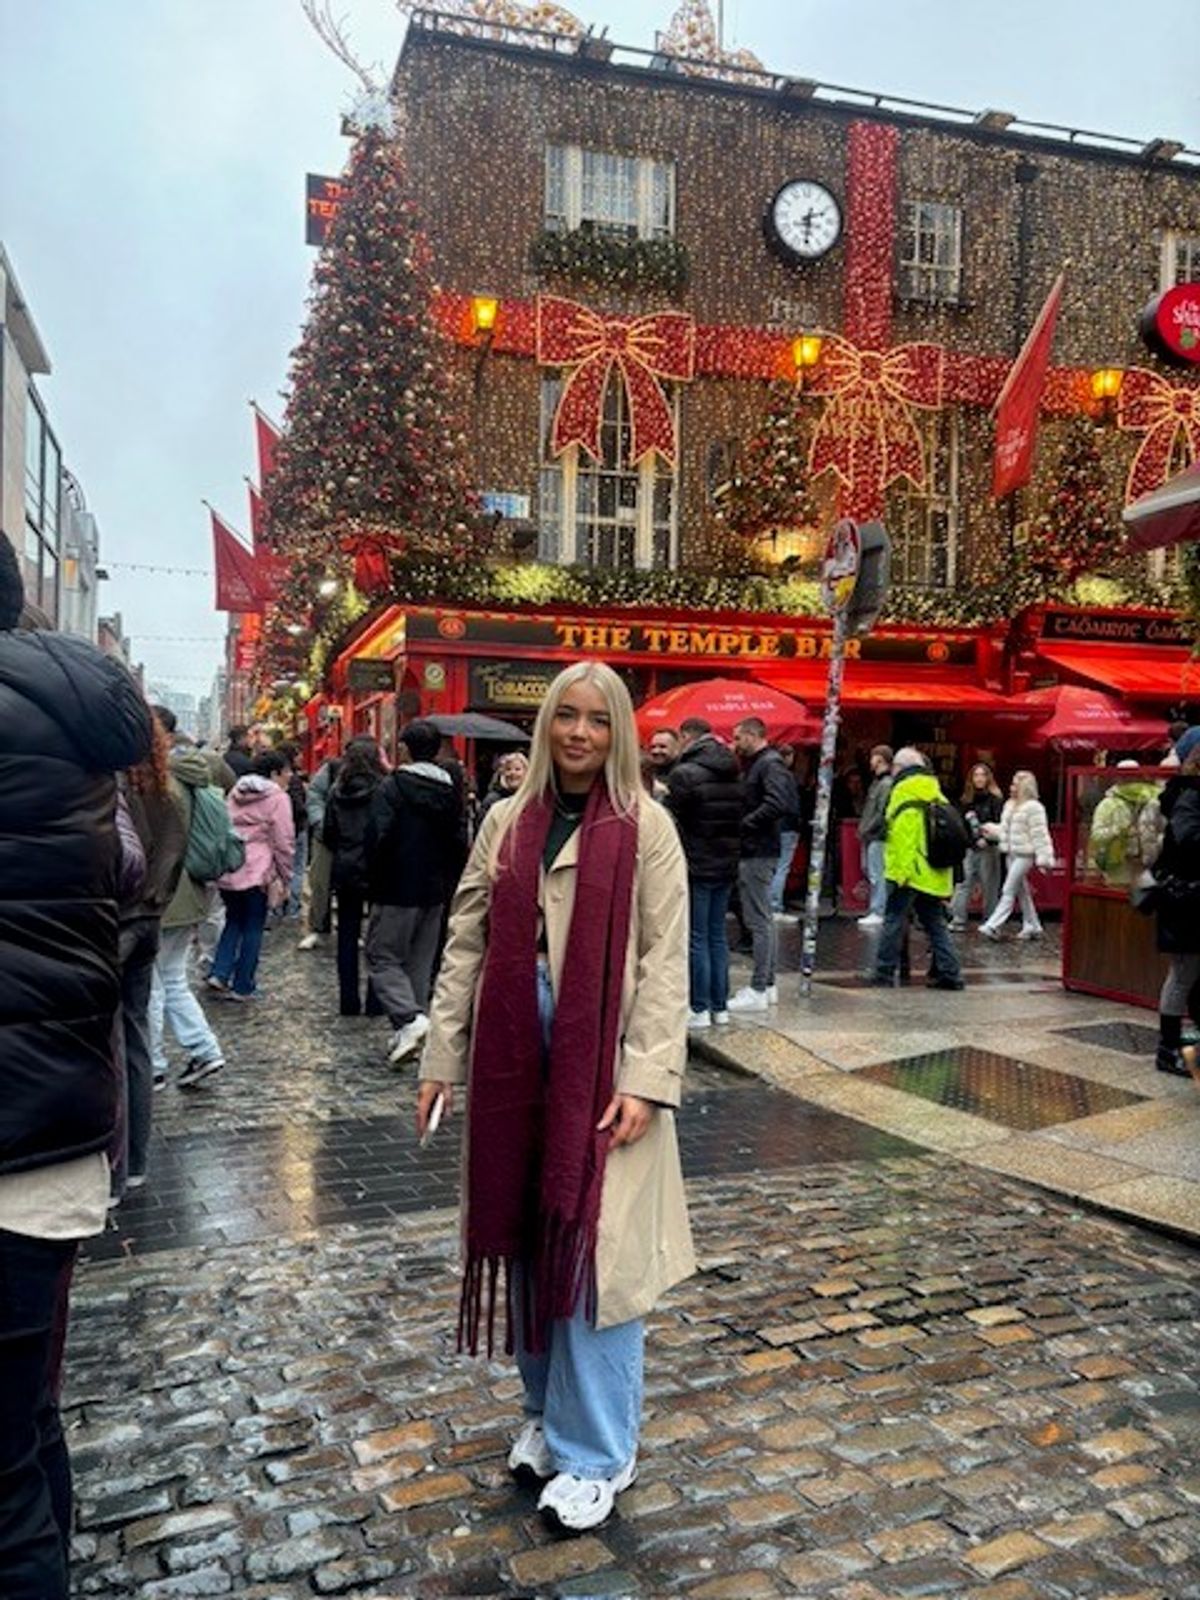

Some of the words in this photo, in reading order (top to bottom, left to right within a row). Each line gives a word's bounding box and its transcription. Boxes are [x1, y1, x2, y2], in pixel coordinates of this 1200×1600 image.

[556, 624, 632, 649] THE
[643, 628, 781, 657] TEMPLE
[796, 636, 862, 659] BAR
